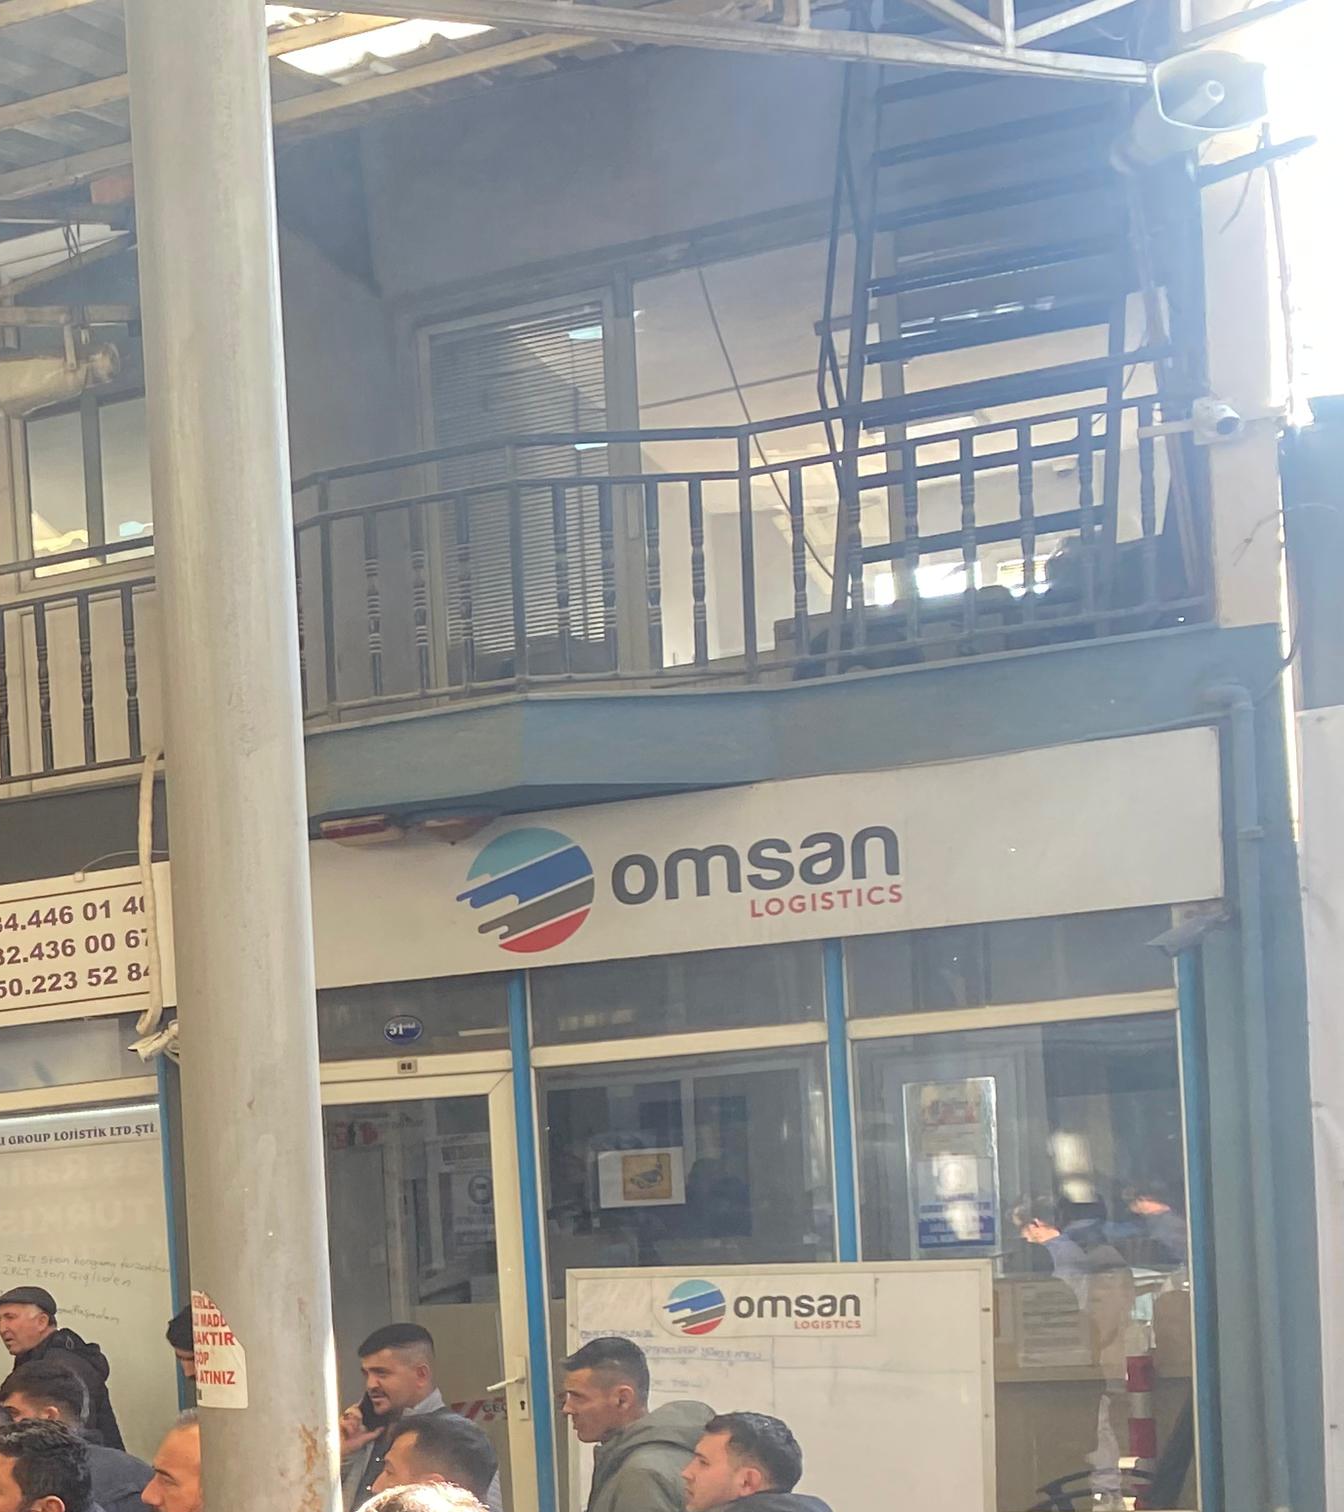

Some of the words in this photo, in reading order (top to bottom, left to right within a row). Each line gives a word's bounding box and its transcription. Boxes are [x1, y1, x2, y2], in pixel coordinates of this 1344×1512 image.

[611, 824, 900, 905] omsan
[82, 899, 111, 921] 01
[749, 883, 904, 919] LOGISTICS
[84, 932, 116, 954] 00
[87, 965, 119, 987] 52
[8, 1133, 51, 1145] GROUP
[733, 1293, 861, 1318] omsan
[794, 1320, 862, 1330] LOGISTICS
